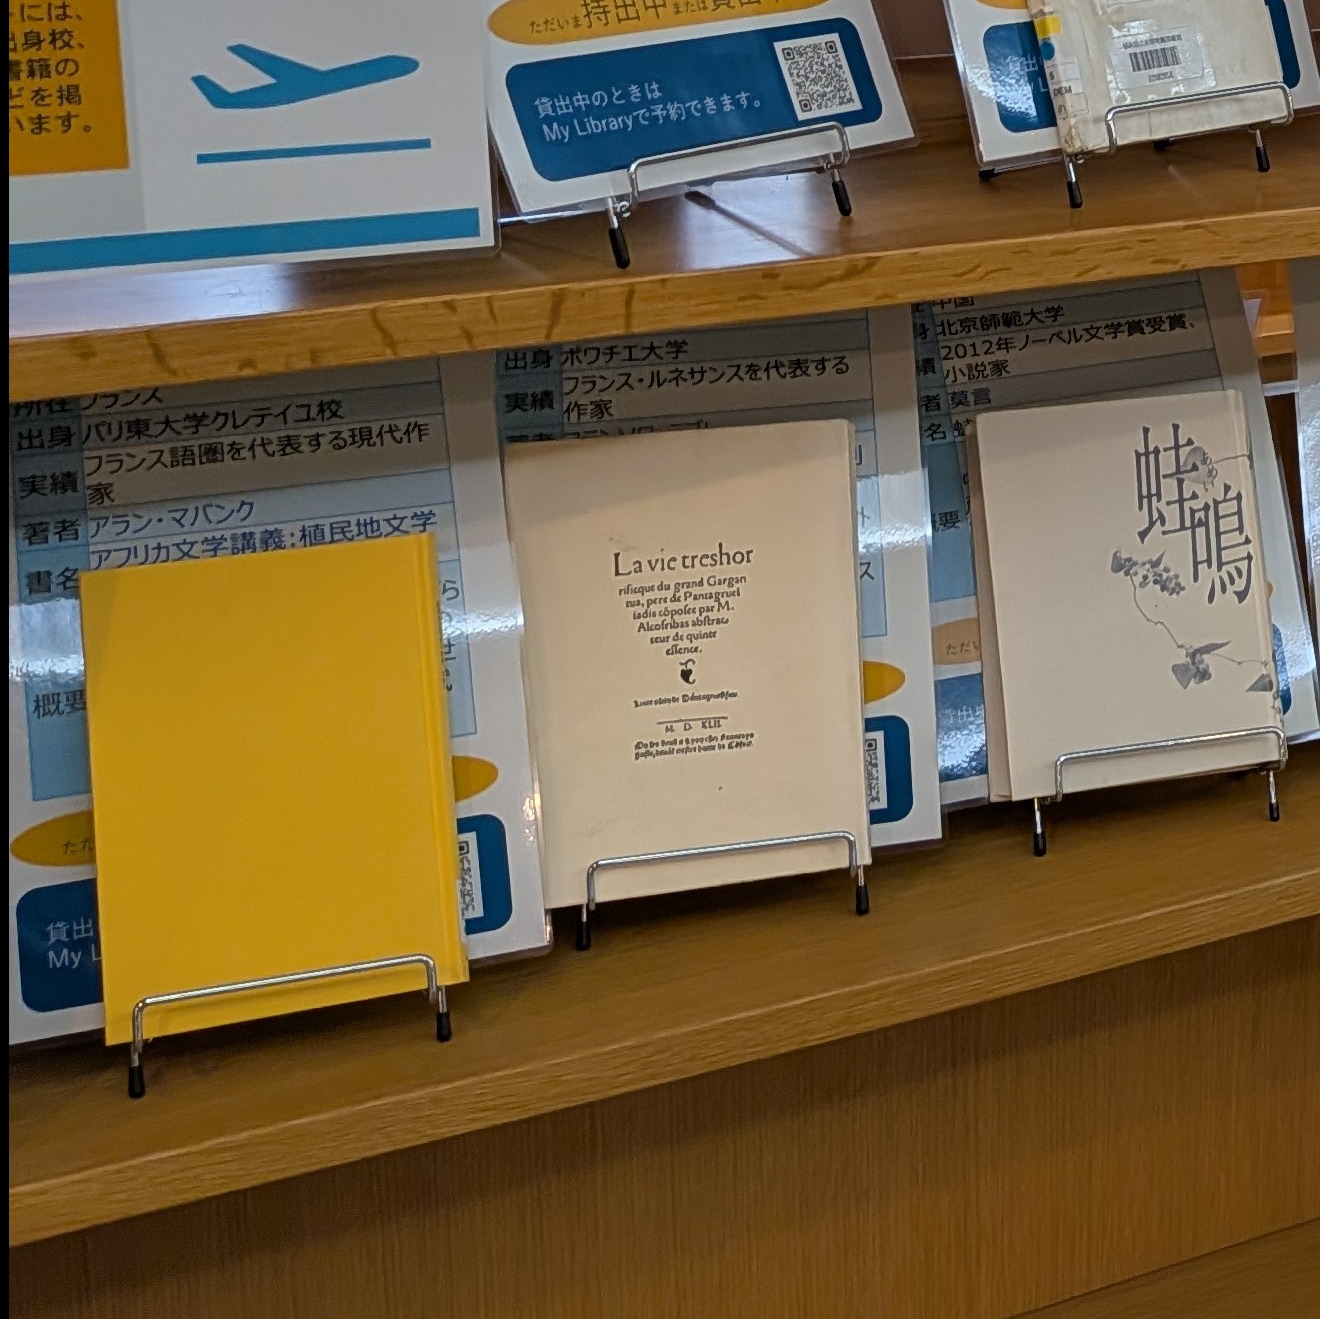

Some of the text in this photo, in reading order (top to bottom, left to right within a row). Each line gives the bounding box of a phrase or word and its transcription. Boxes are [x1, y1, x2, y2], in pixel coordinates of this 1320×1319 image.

[534, 81, 663, 119] 貸出中のときは
[542, 90, 763, 144] My Libraryで予約できます。
[936, 304, 1065, 336] 北京師範大学
[940, 312, 1197, 362] 2012年ノーベル文学賞受賞、
[563, 355, 850, 397] フランス・ルネサンスを代表する
[944, 359, 1011, 384] 小説家
[504, 392, 614, 424] 実績 作家
[950, 386, 993, 408] 莫言
[16, 398, 344, 452] 出身 パリ東大学クレテイユ校
[84, 420, 431, 478] フランス語圏を代表する現代作
[19, 473, 116, 506] 実績 家
[21, 500, 255, 546] 著者 アラン・マバンク
[1133, 422, 1255, 605] 蛙鳴
[613, 542, 754, 577] La vie treshor
[26, 567, 80, 594] 書名
[669, 587, 741, 603] de Pantagruel
[673, 575, 747, 594] grand Gargan
